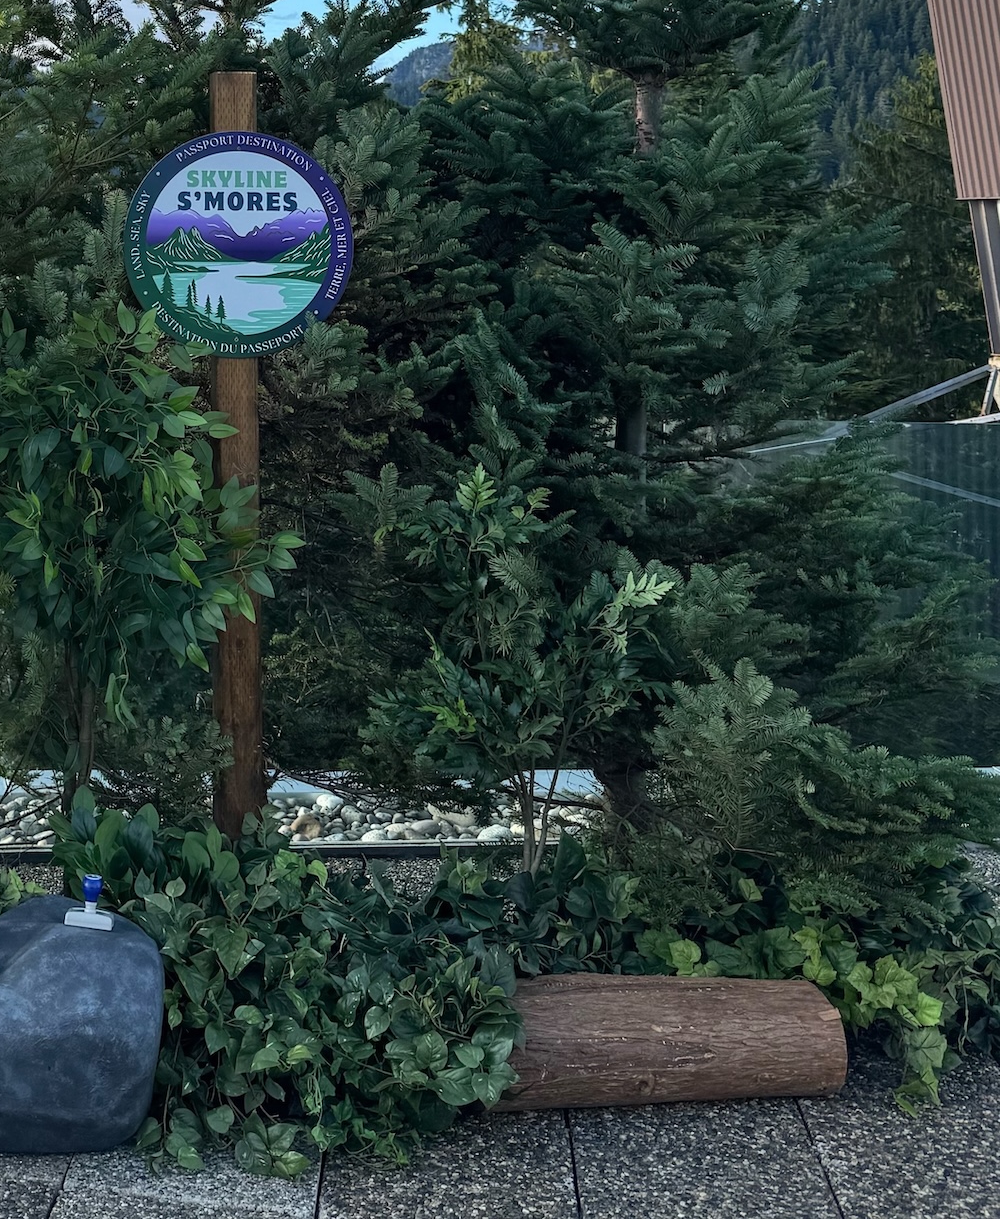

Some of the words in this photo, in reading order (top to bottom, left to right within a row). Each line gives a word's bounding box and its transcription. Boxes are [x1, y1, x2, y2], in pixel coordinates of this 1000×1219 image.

[175, 135, 234, 162] PASSPORT
[237, 135, 313, 172] DESTINATION
[186, 169, 288, 188] SKYLINE
[135, 189, 151, 214] SKY
[177, 191, 298, 211] S’MORES
[321, 187, 339, 214] CIEL
[332, 217, 345, 231] ET
[336, 233, 347, 259] MER
[324, 262, 346, 300] TERRE,
[220, 342, 238, 354] DU
[240, 324, 304, 354] PASSEPORT
